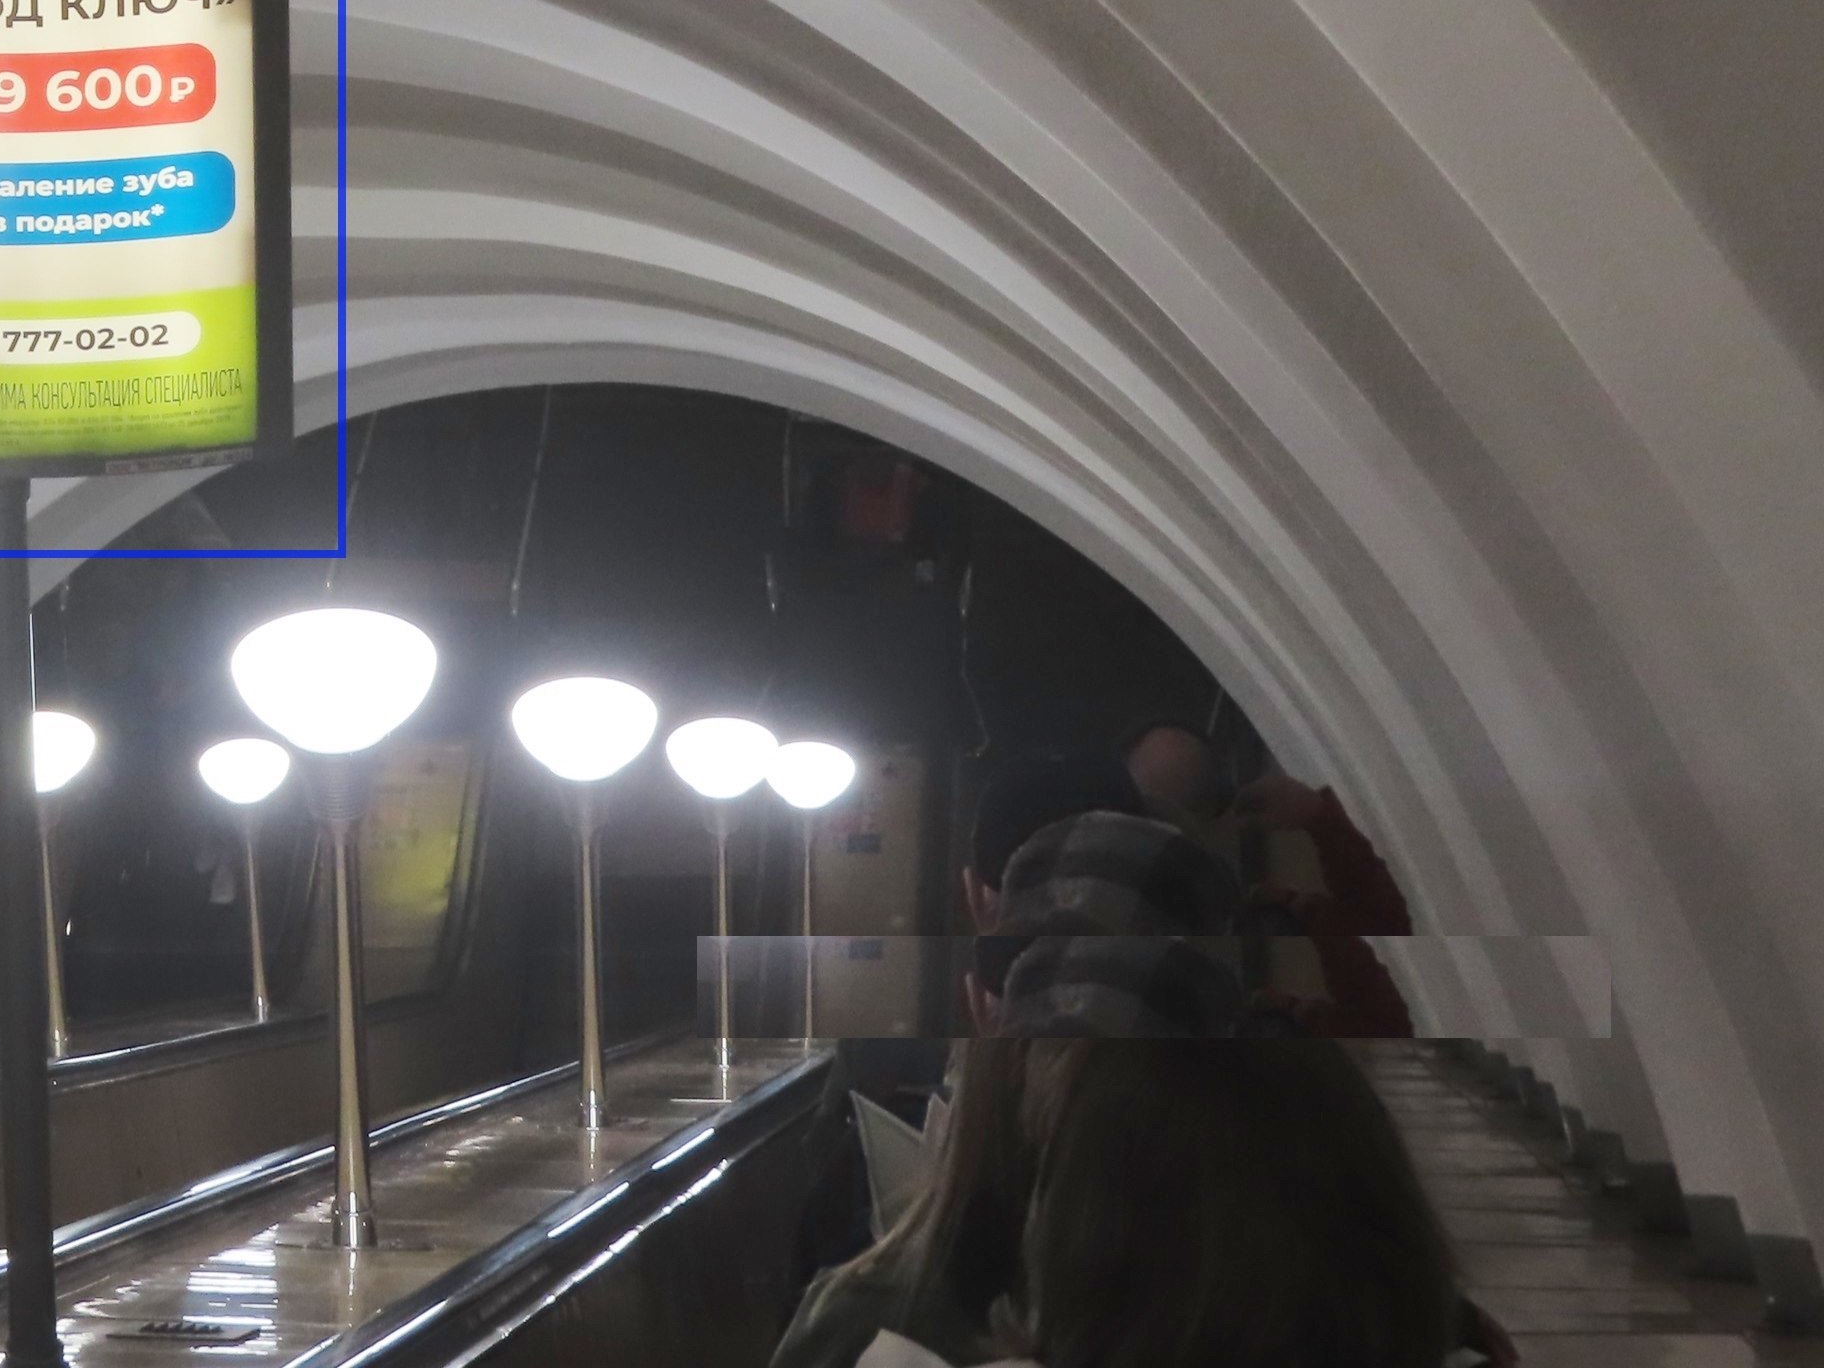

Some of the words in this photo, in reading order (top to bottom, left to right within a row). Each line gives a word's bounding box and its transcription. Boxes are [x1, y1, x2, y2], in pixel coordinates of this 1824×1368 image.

[122, 166, 194, 196] зуба
[2, 323, 170, 352] 777-02-02
[31, 378, 140, 410] КОНСУЛЬТАЦИЯ
[145, 368, 243, 405] СПЕЦИАЛИСТА
